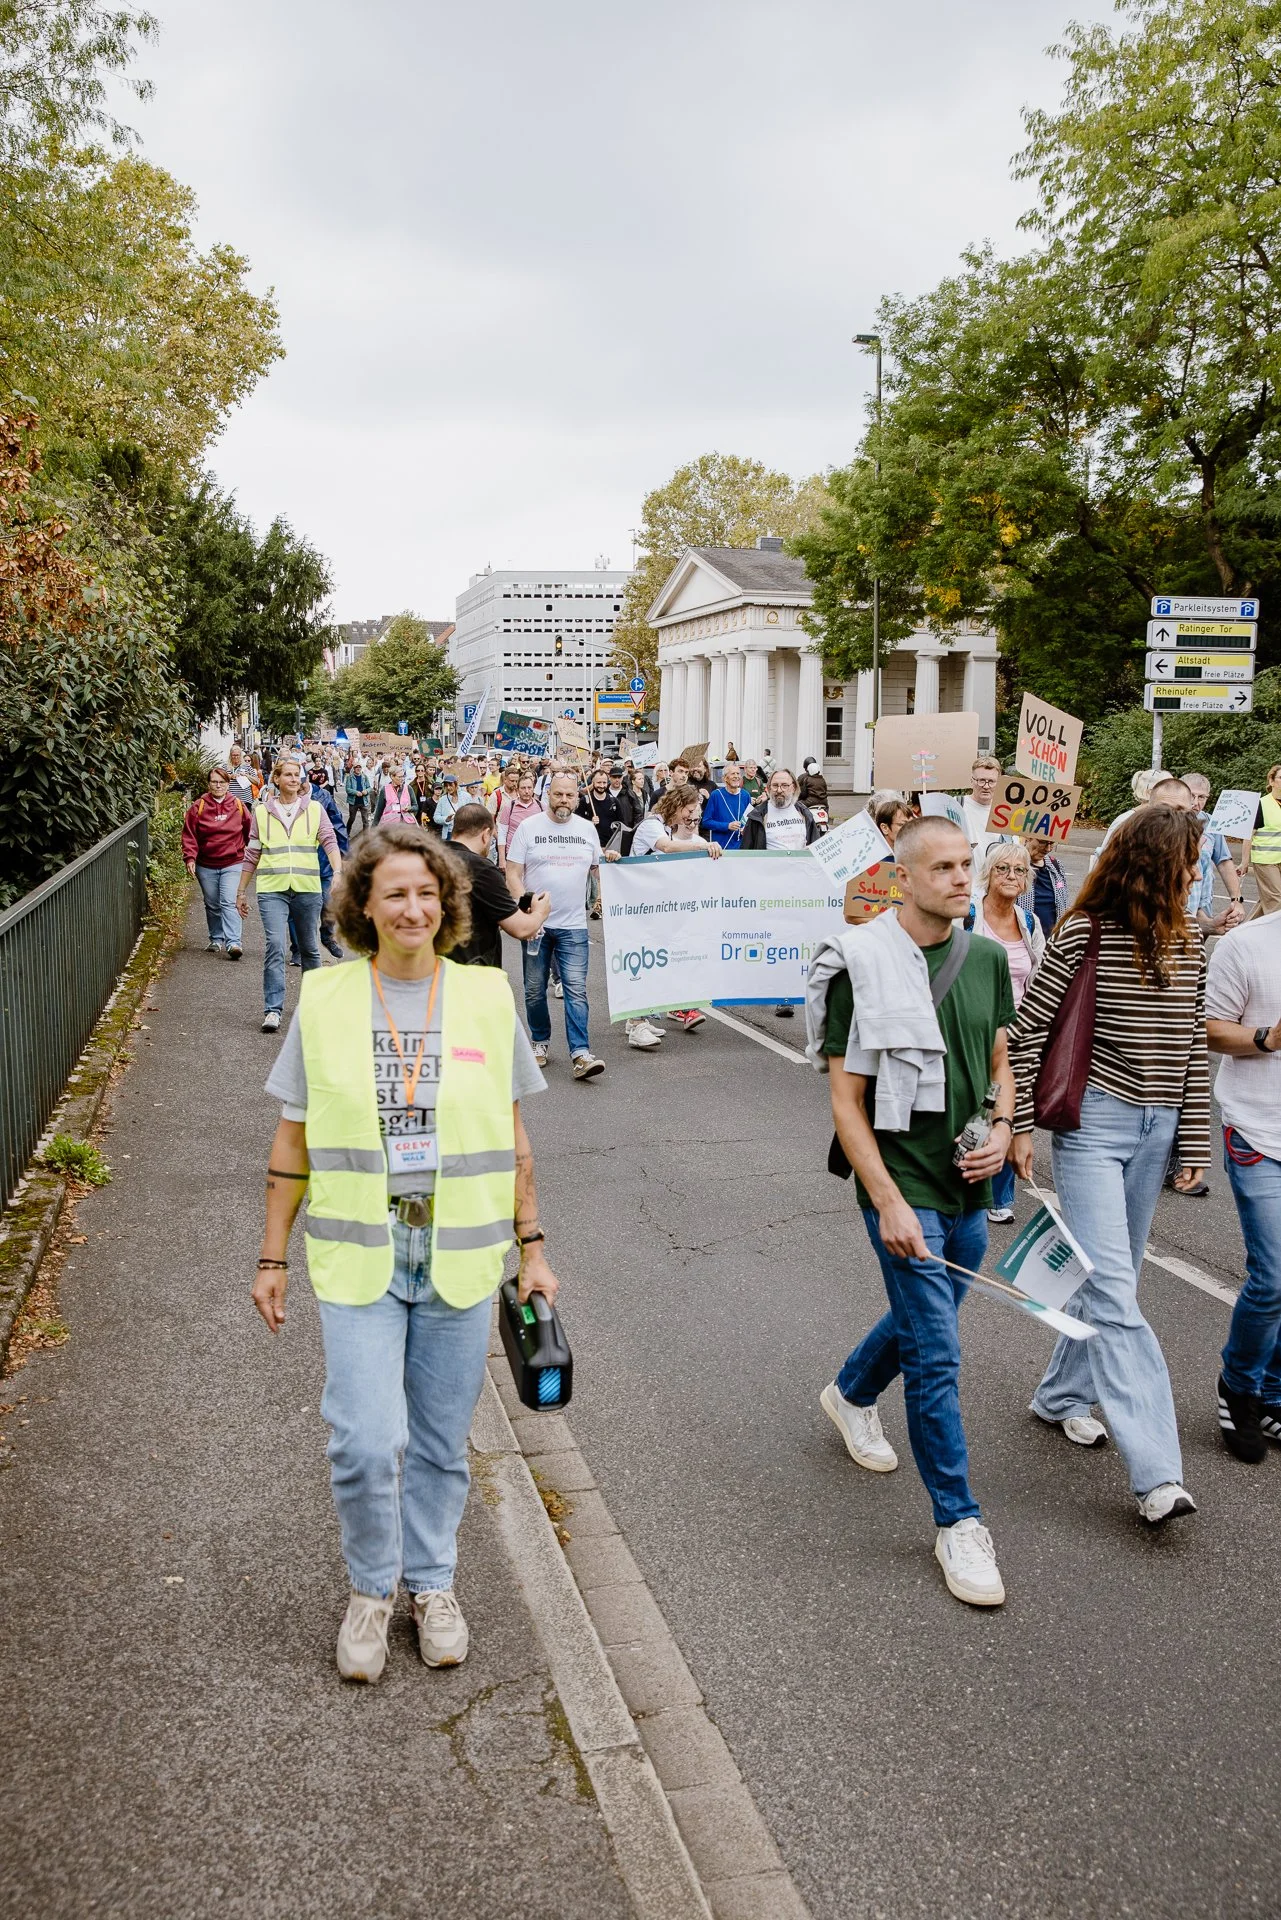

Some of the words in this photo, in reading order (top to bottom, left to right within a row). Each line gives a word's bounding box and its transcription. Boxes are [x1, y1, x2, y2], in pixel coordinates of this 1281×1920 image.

[1174, 603, 1237, 614] Parkleitsystem
[1179, 624, 1215, 634] Ratinger
[1219, 625, 1233, 633] Tor
[1177, 656, 1211, 665] Altstadt
[1156, 687, 1197, 696] Rheinufer
[1025, 709, 1067, 746] VOLL
[1028, 736, 1068, 773] SCHÖN
[1031, 759, 1056, 783] HIER
[1005, 782, 1072, 812] 0,0%
[991, 804, 1072, 840] SCHAM
[534, 835, 547, 844] Die
[815, 836, 835, 851] JEDER
[818, 838, 844, 857] SCHRITT
[858, 881, 888, 896] Sober
[889, 885, 903, 898] Bu
[609, 904, 622, 917] Wir
[624, 903, 654, 915] laufen
[655, 900, 678, 914] nicht
[680, 900, 699, 912] weg,
[700, 897, 718, 908] wir
[721, 897, 757, 908] laufen
[759, 897, 825, 911] gemeinsam
[827, 896, 843, 907] los
[721, 931, 772, 939] Kommunale
[611, 946, 668, 976] drobs
[373, 1032, 425, 1052] kein
[374, 1056, 442, 1078] ensch
[377, 1082, 398, 1104] st
[379, 1109, 427, 1136] egal
[395, 1141, 431, 1151] CREW
